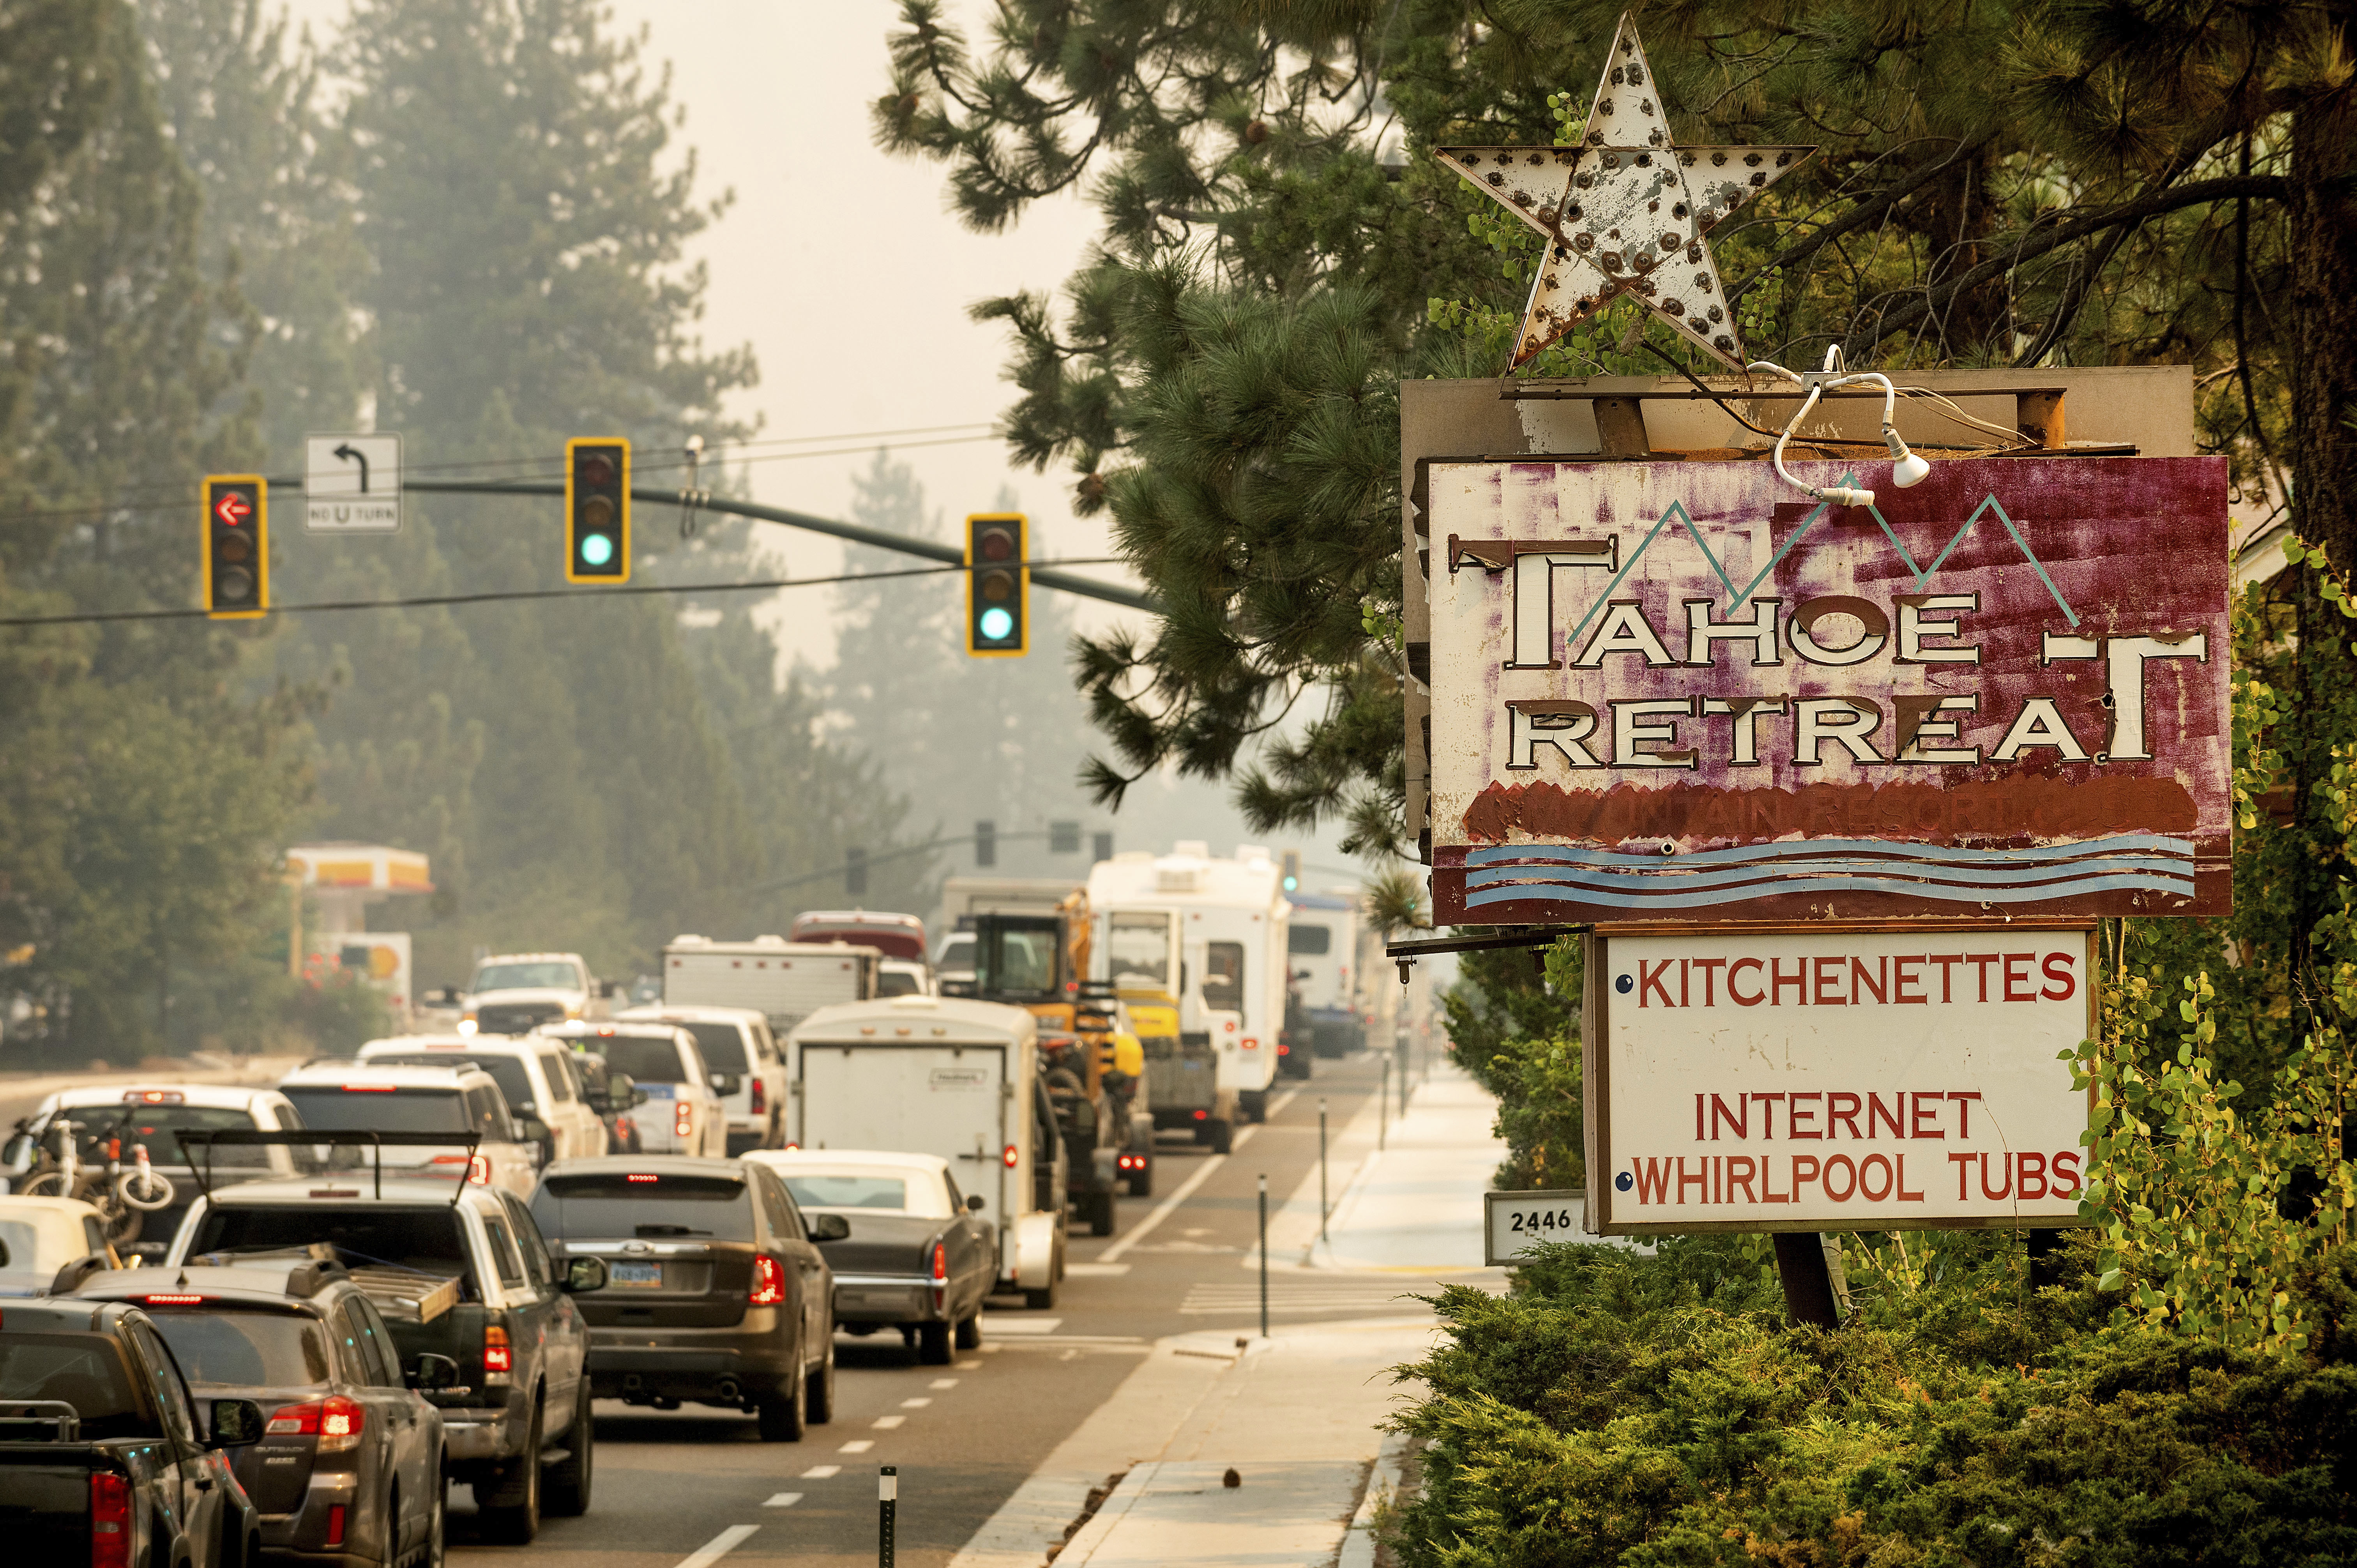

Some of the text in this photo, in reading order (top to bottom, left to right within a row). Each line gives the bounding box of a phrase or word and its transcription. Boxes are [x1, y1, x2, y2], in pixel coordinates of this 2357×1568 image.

[310, 506, 394, 524] NO U TURN
[1447, 533, 1982, 671] TAHOE
[1504, 625, 2209, 770] RETREAT
[1638, 952, 2076, 1008] KITCHENETTES
[1695, 1091, 1982, 1141] INTERNET
[1631, 1151, 2081, 1204] WHIRLPOOL TUBS
[1511, 1209, 1571, 1232] 2446
